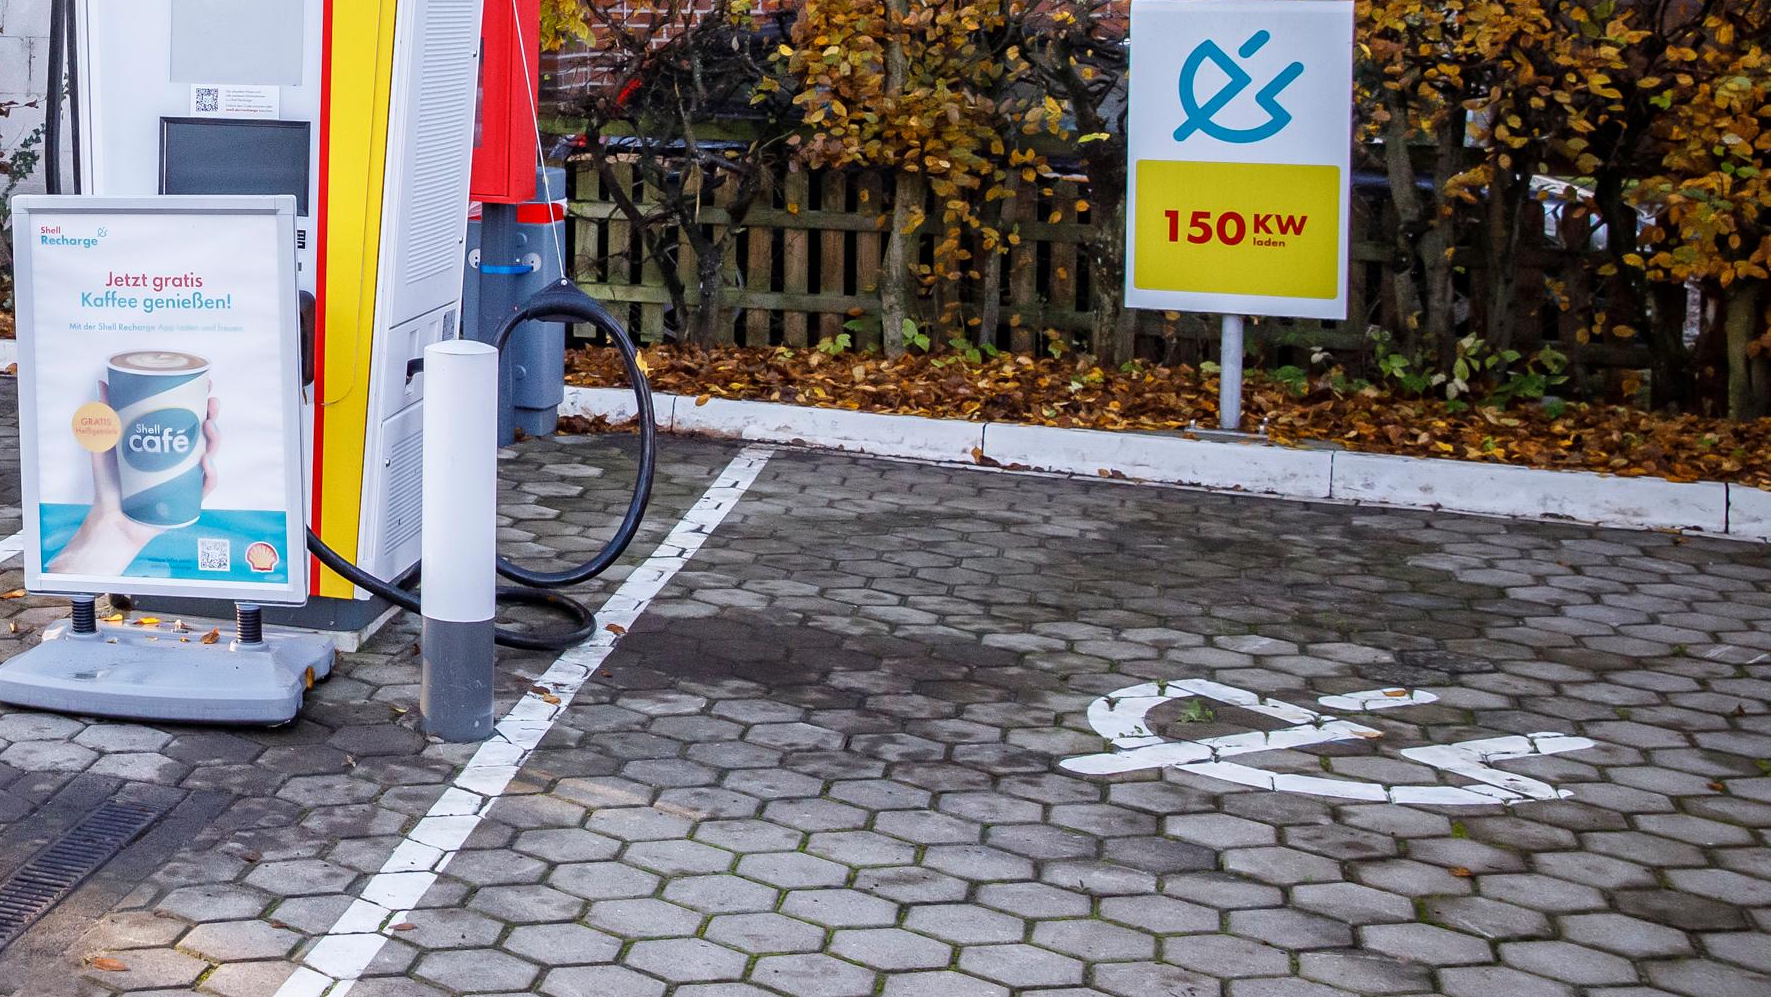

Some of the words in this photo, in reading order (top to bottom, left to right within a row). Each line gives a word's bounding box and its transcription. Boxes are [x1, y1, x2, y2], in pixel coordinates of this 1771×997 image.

[40, 226, 61, 234] Shell
[1164, 209, 1247, 246] 150
[1253, 213, 1308, 236] KW
[41, 234, 98, 249] Recharge
[1252, 237, 1286, 248] laden
[105, 271, 148, 287] Jetzt
[152, 272, 203, 292] gratis
[81, 291, 138, 308] Kaffee
[143, 291, 231, 314] genießen!
[69, 323, 82, 331] Mit
[83, 323, 96, 331] der
[98, 323, 117, 331] Shell
[118, 323, 156, 333] Recharge
[135, 423, 161, 434] Shell
[129, 427, 189, 453] café
